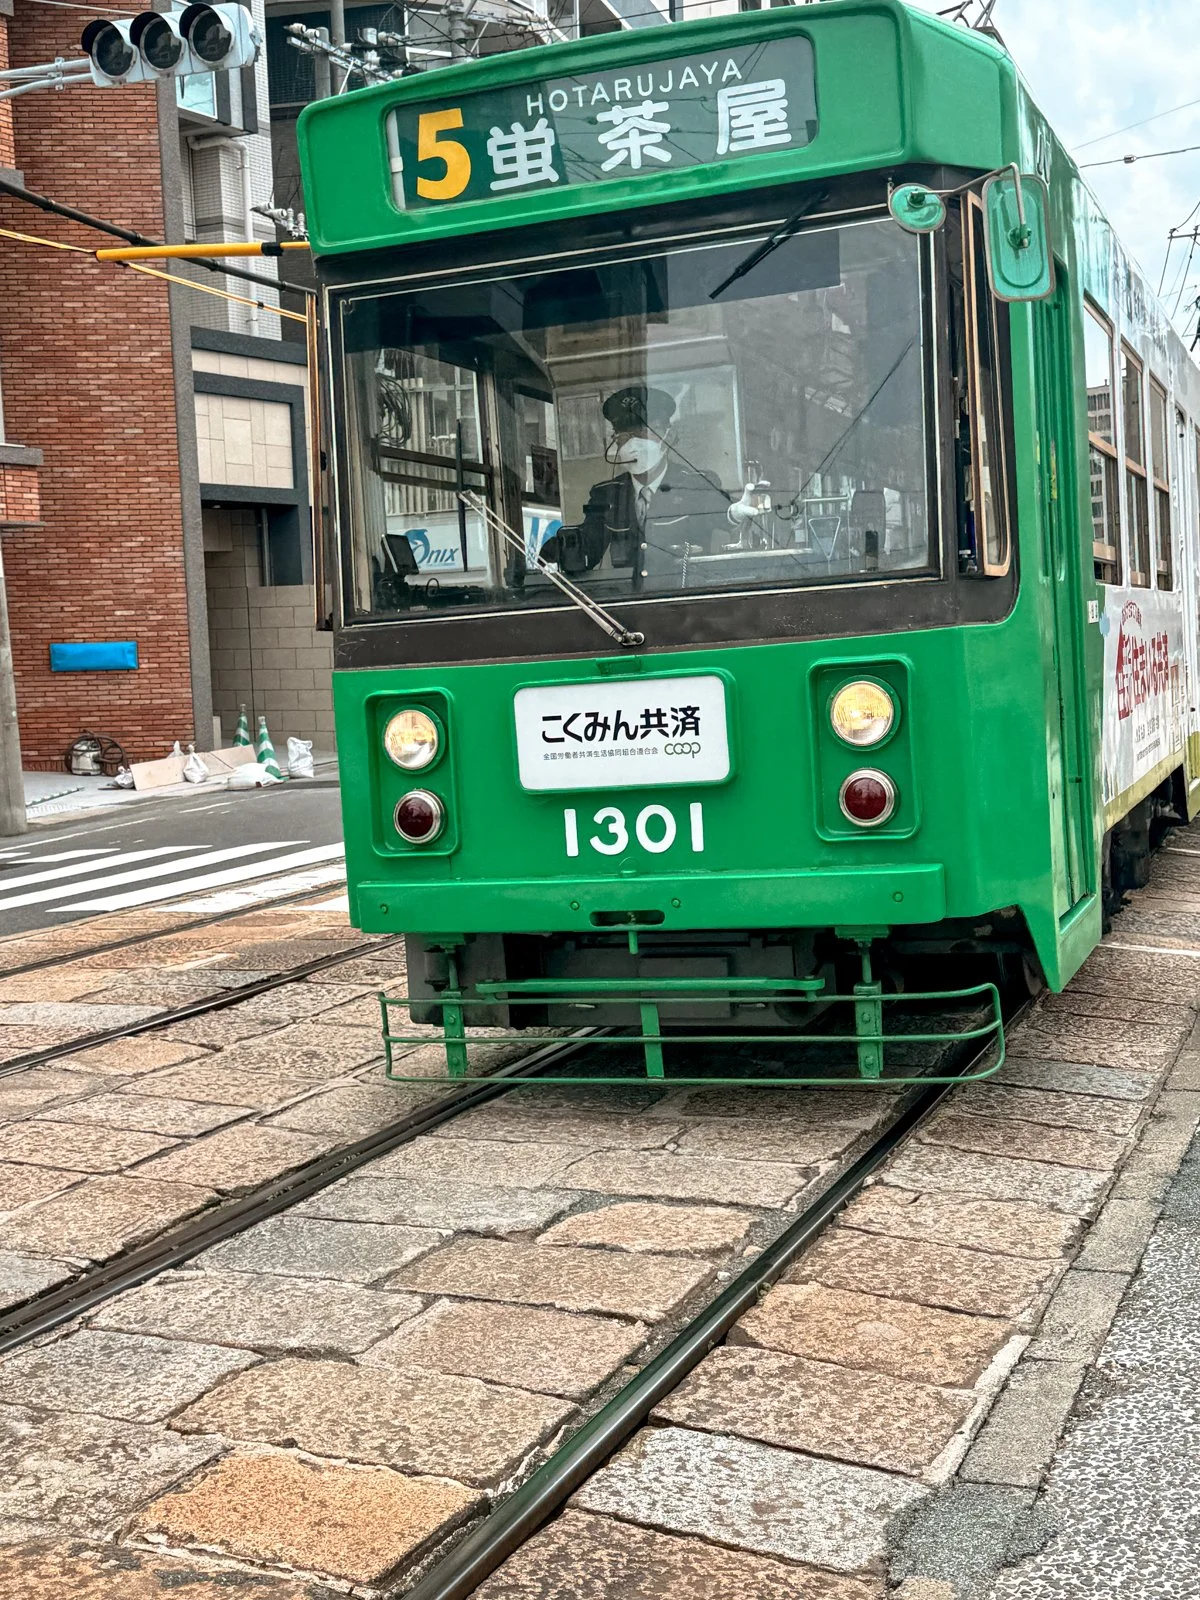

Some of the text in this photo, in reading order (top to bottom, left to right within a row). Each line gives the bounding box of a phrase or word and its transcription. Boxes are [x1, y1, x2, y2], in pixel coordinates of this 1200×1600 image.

[526, 58, 742, 116] HOTARUJAYA
[416, 78, 792, 200] 5 蛍茶屋
[541, 705, 701, 743] こくみん共済
[563, 802, 705, 857] 1301
